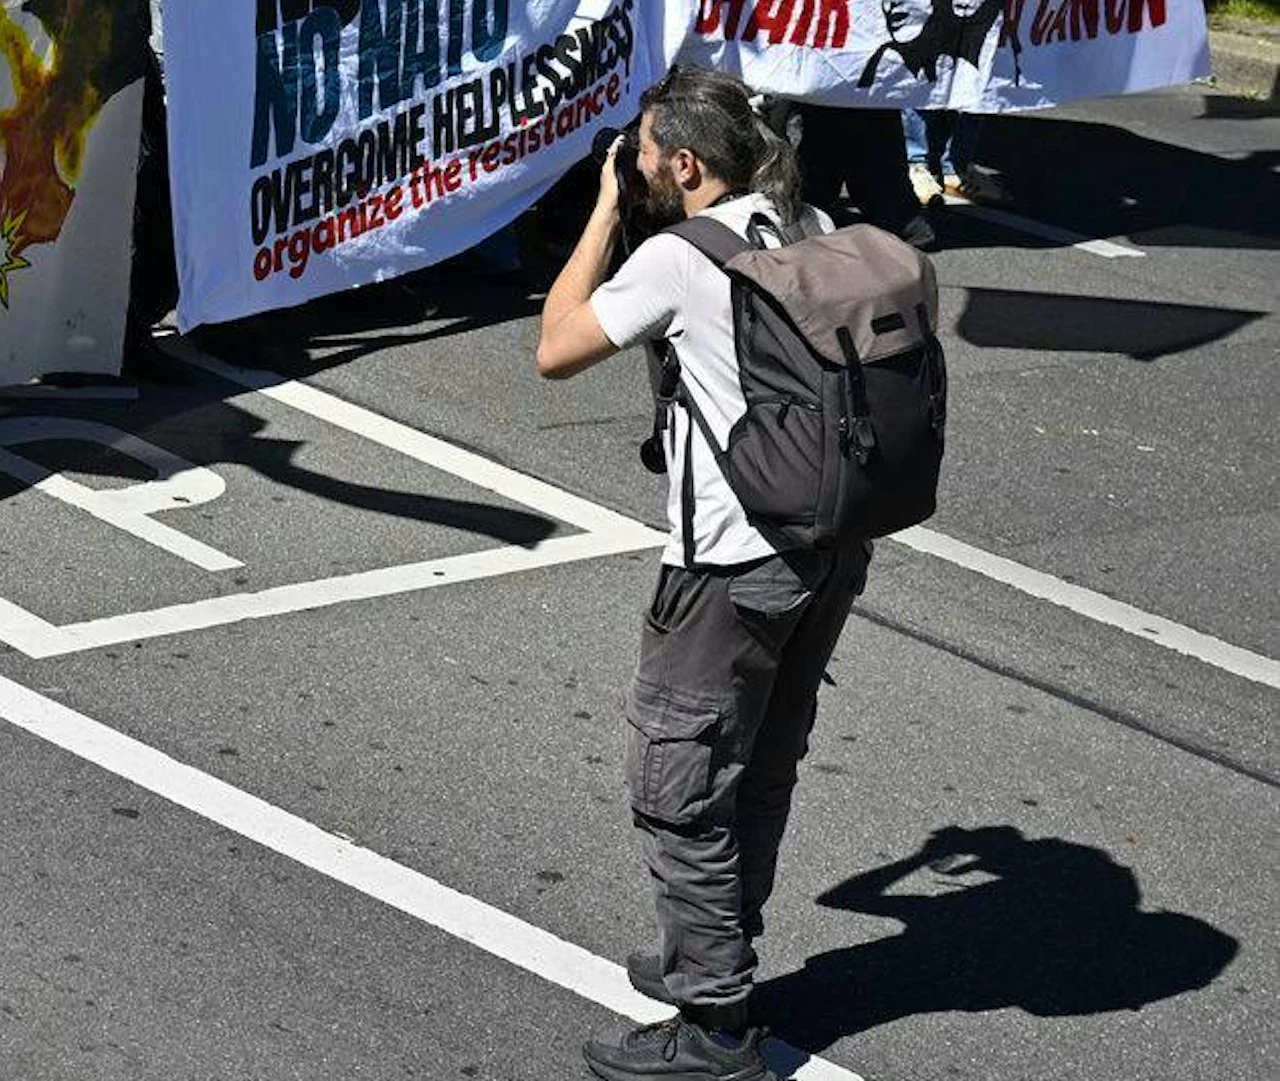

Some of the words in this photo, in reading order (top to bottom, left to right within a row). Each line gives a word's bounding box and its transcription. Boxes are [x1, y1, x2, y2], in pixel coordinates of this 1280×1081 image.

[250, 6, 340, 168] NO
[251, 126, 427, 243] OVERCOME
[253, 187, 400, 282] organize
[408, 158, 462, 209] the
